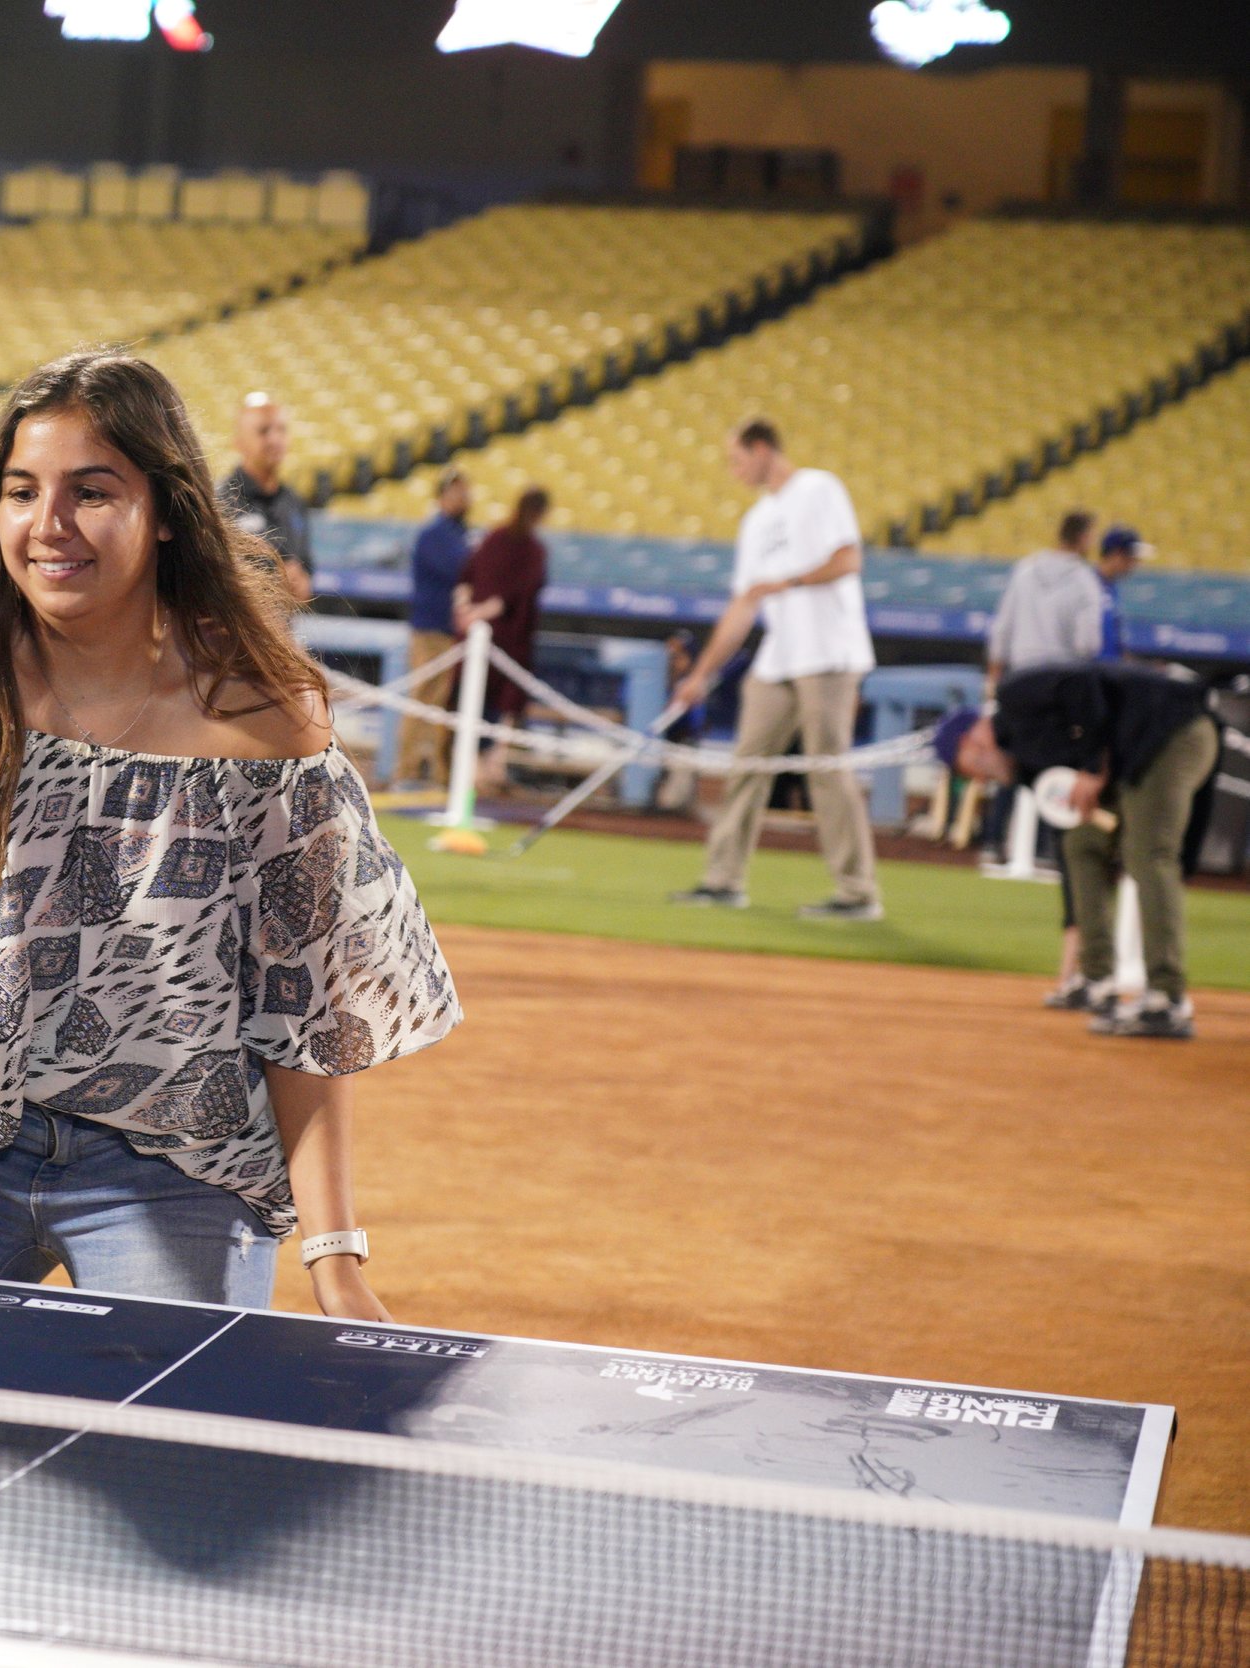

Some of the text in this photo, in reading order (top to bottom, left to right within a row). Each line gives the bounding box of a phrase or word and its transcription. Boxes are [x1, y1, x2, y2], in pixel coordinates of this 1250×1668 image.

[36, 1301, 99, 1313] UCLA
[335, 1335, 488, 1359] HIHO
[922, 1406, 1057, 1430] PING
